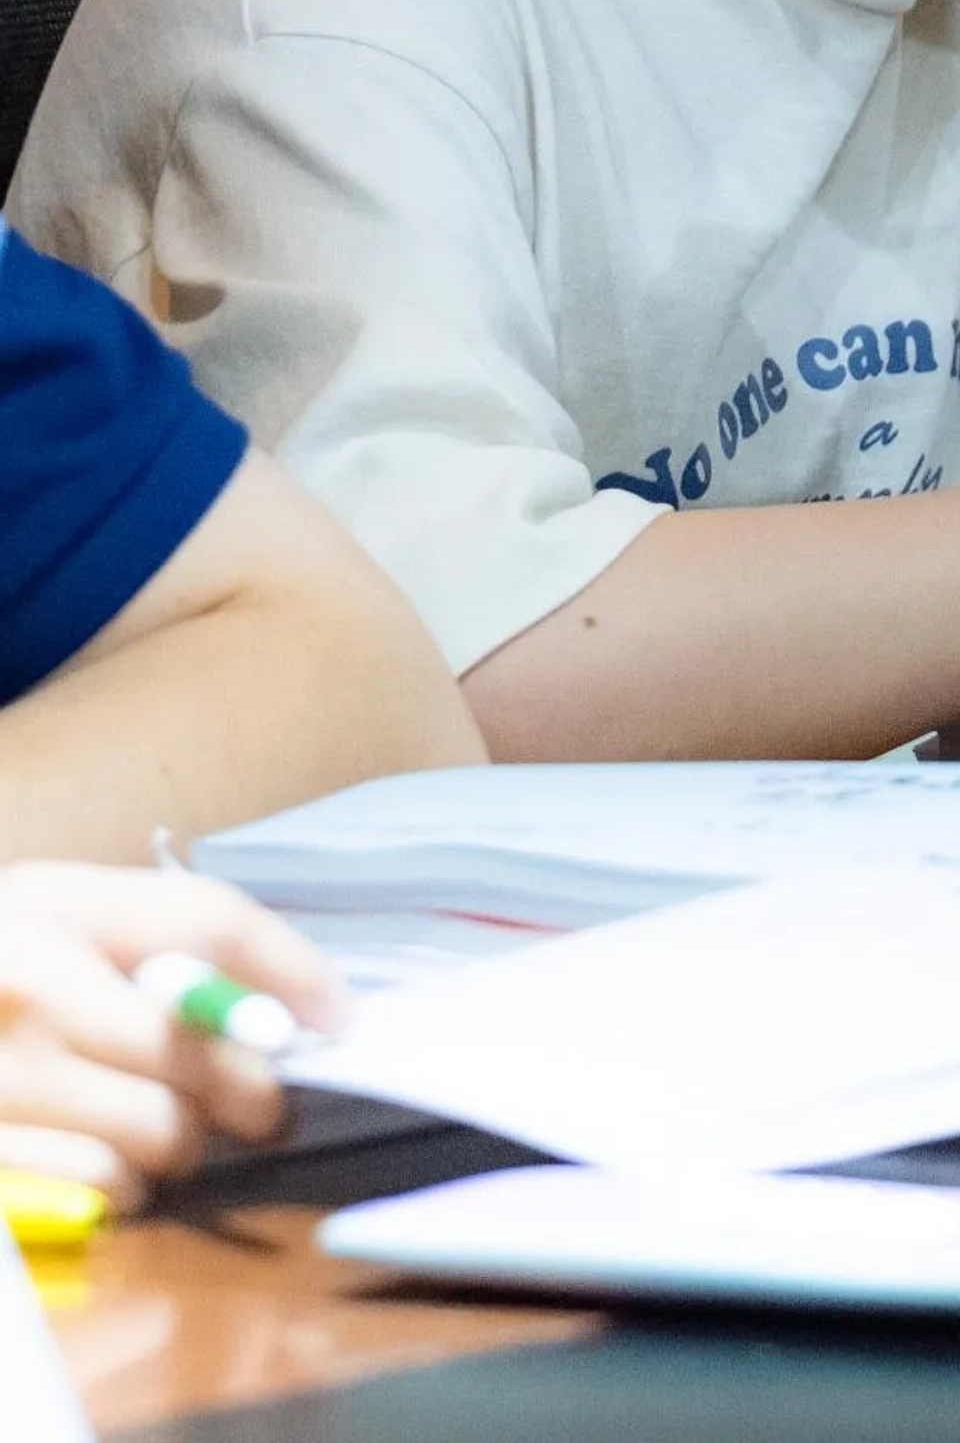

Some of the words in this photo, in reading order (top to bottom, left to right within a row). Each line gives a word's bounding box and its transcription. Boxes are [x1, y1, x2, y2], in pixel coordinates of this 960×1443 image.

[595, 438, 712, 511] No
[718, 358, 788, 459] one
[797, 319, 939, 391] can
[859, 420, 899, 451] a
